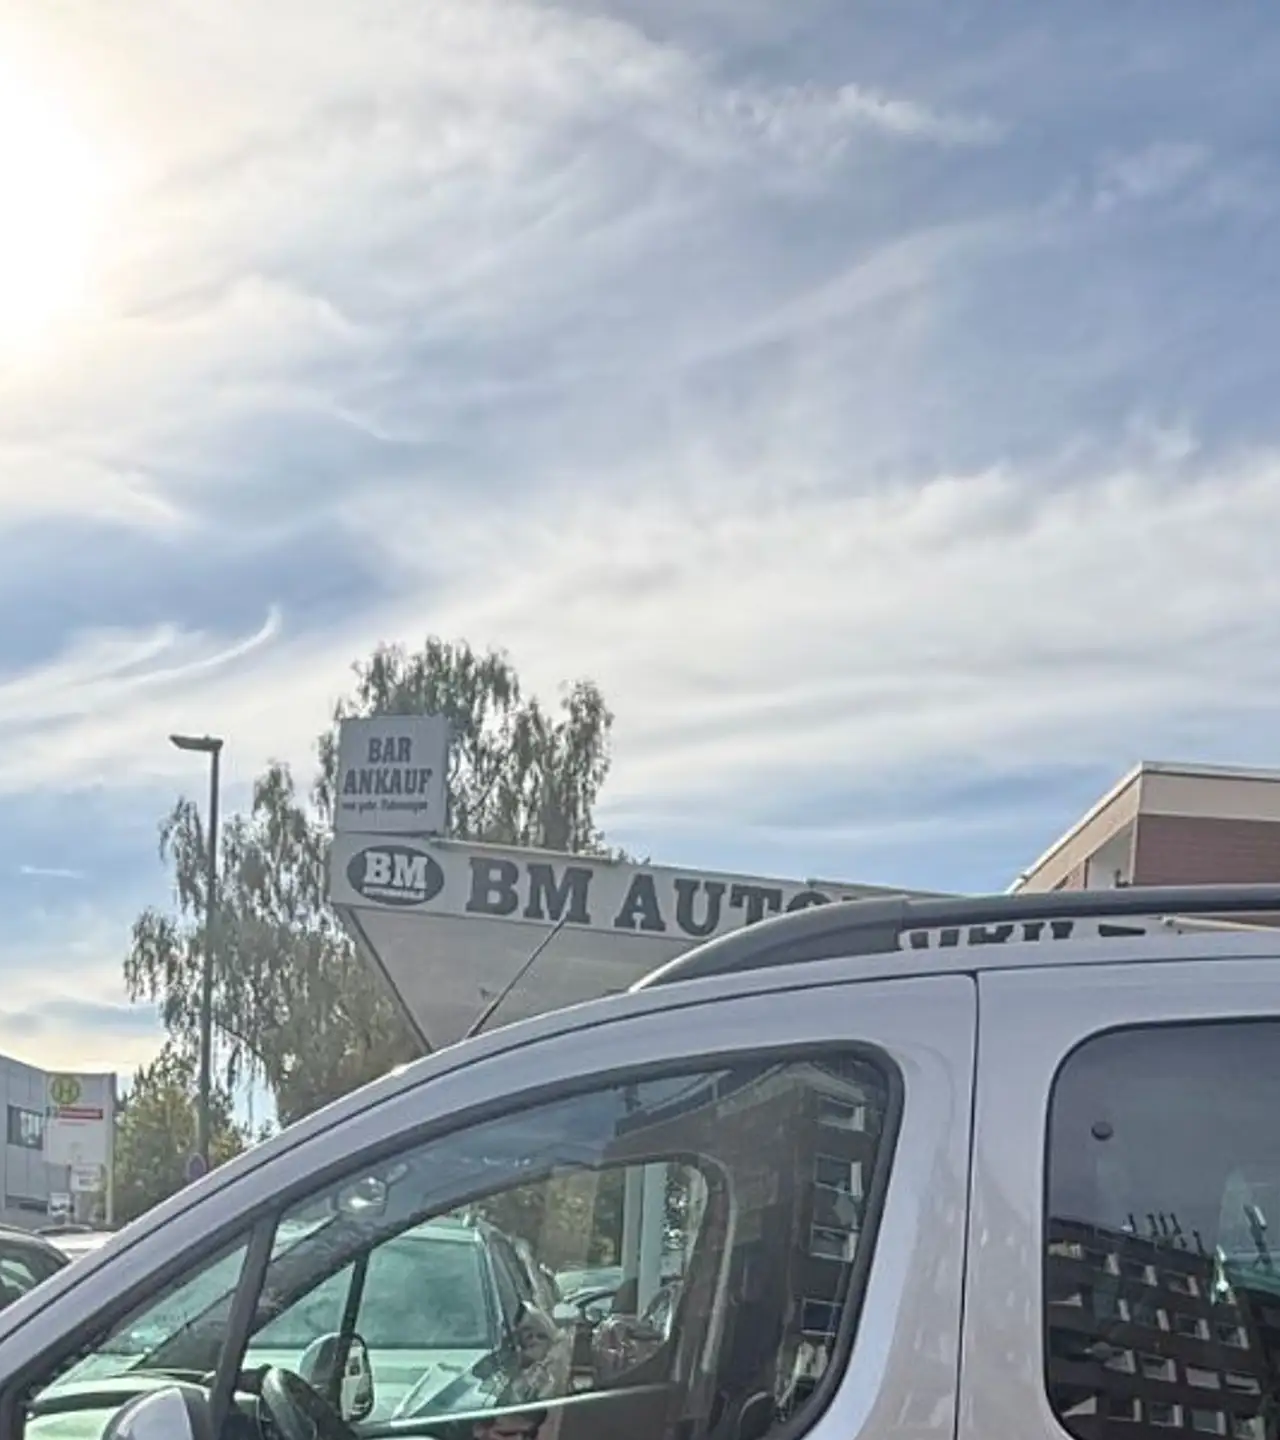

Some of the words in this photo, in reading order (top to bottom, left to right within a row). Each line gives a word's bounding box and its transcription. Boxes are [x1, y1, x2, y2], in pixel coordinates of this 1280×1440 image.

[368, 736, 413, 764] BAR
[343, 767, 434, 796] ANKAUF
[362, 851, 429, 890] BM
[465, 856, 594, 926] BM
